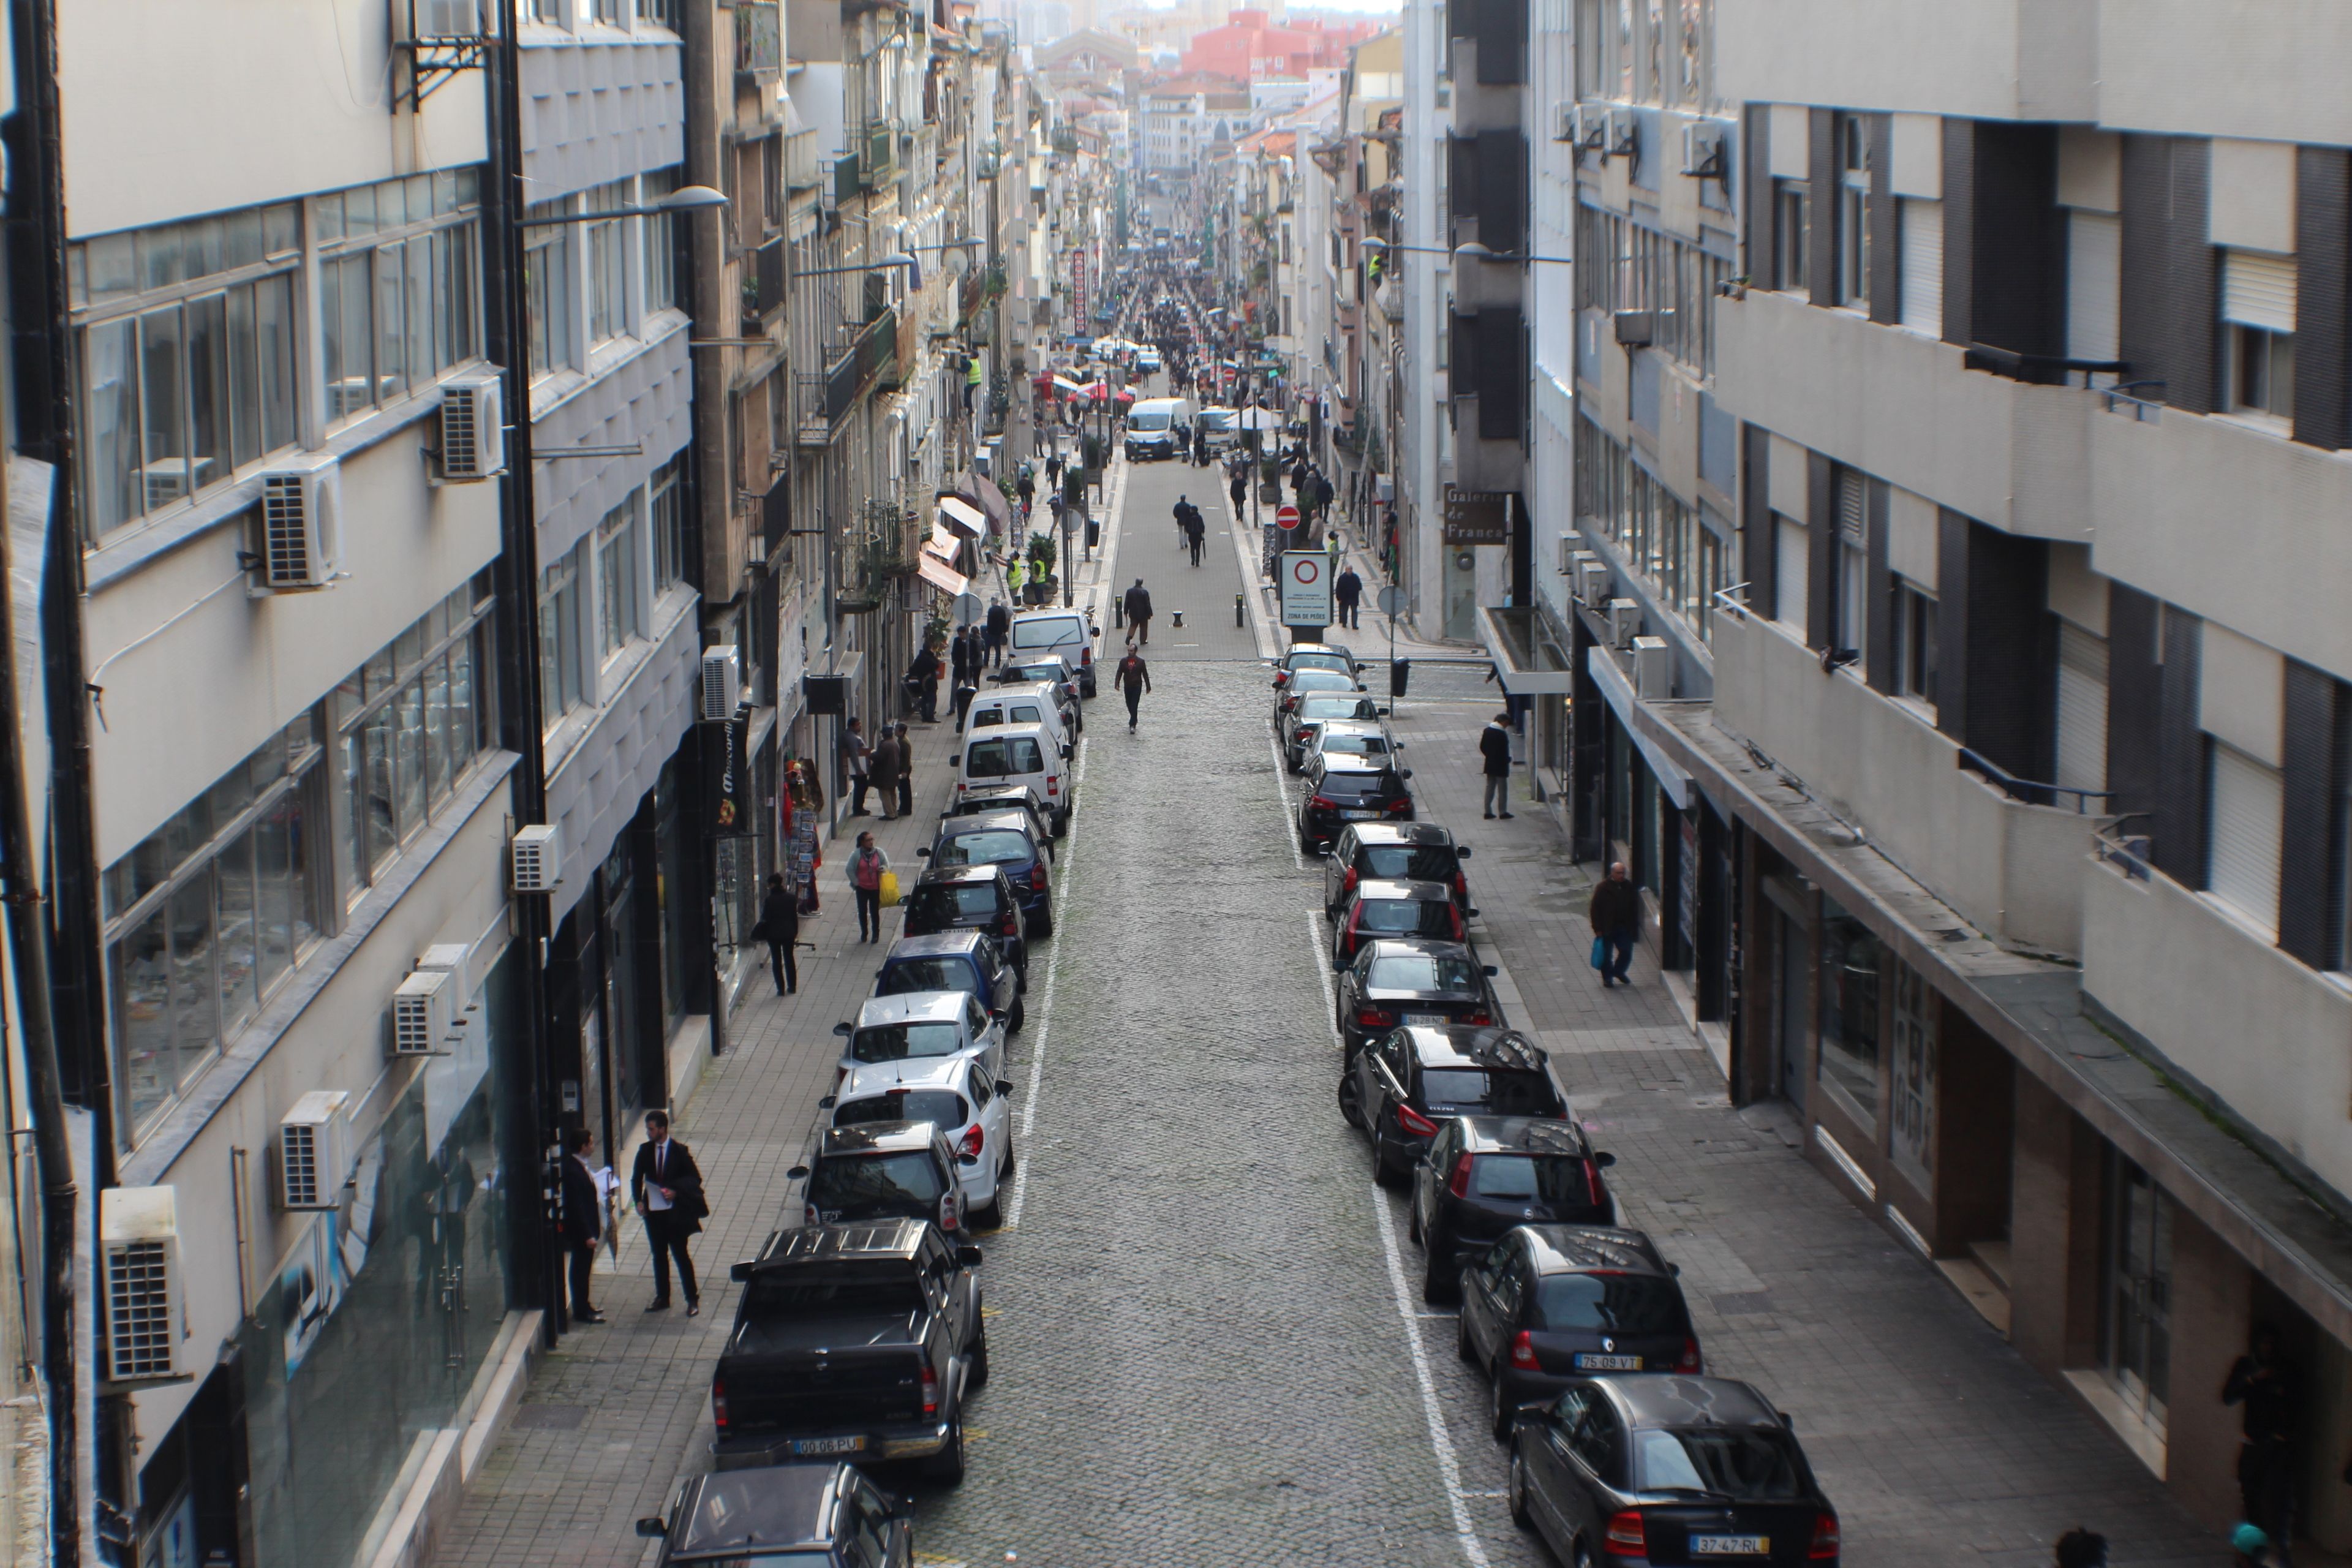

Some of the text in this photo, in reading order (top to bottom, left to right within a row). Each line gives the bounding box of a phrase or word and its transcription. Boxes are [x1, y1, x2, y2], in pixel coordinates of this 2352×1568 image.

[1447, 489, 1503, 502] Galeria
[1447, 505, 1464, 519] de
[1583, 1356, 1636, 1369] 75-09-VT
[801, 1438, 856, 1453] 00-06-PU
[1700, 1539, 1760, 1553] 37-47-RL
